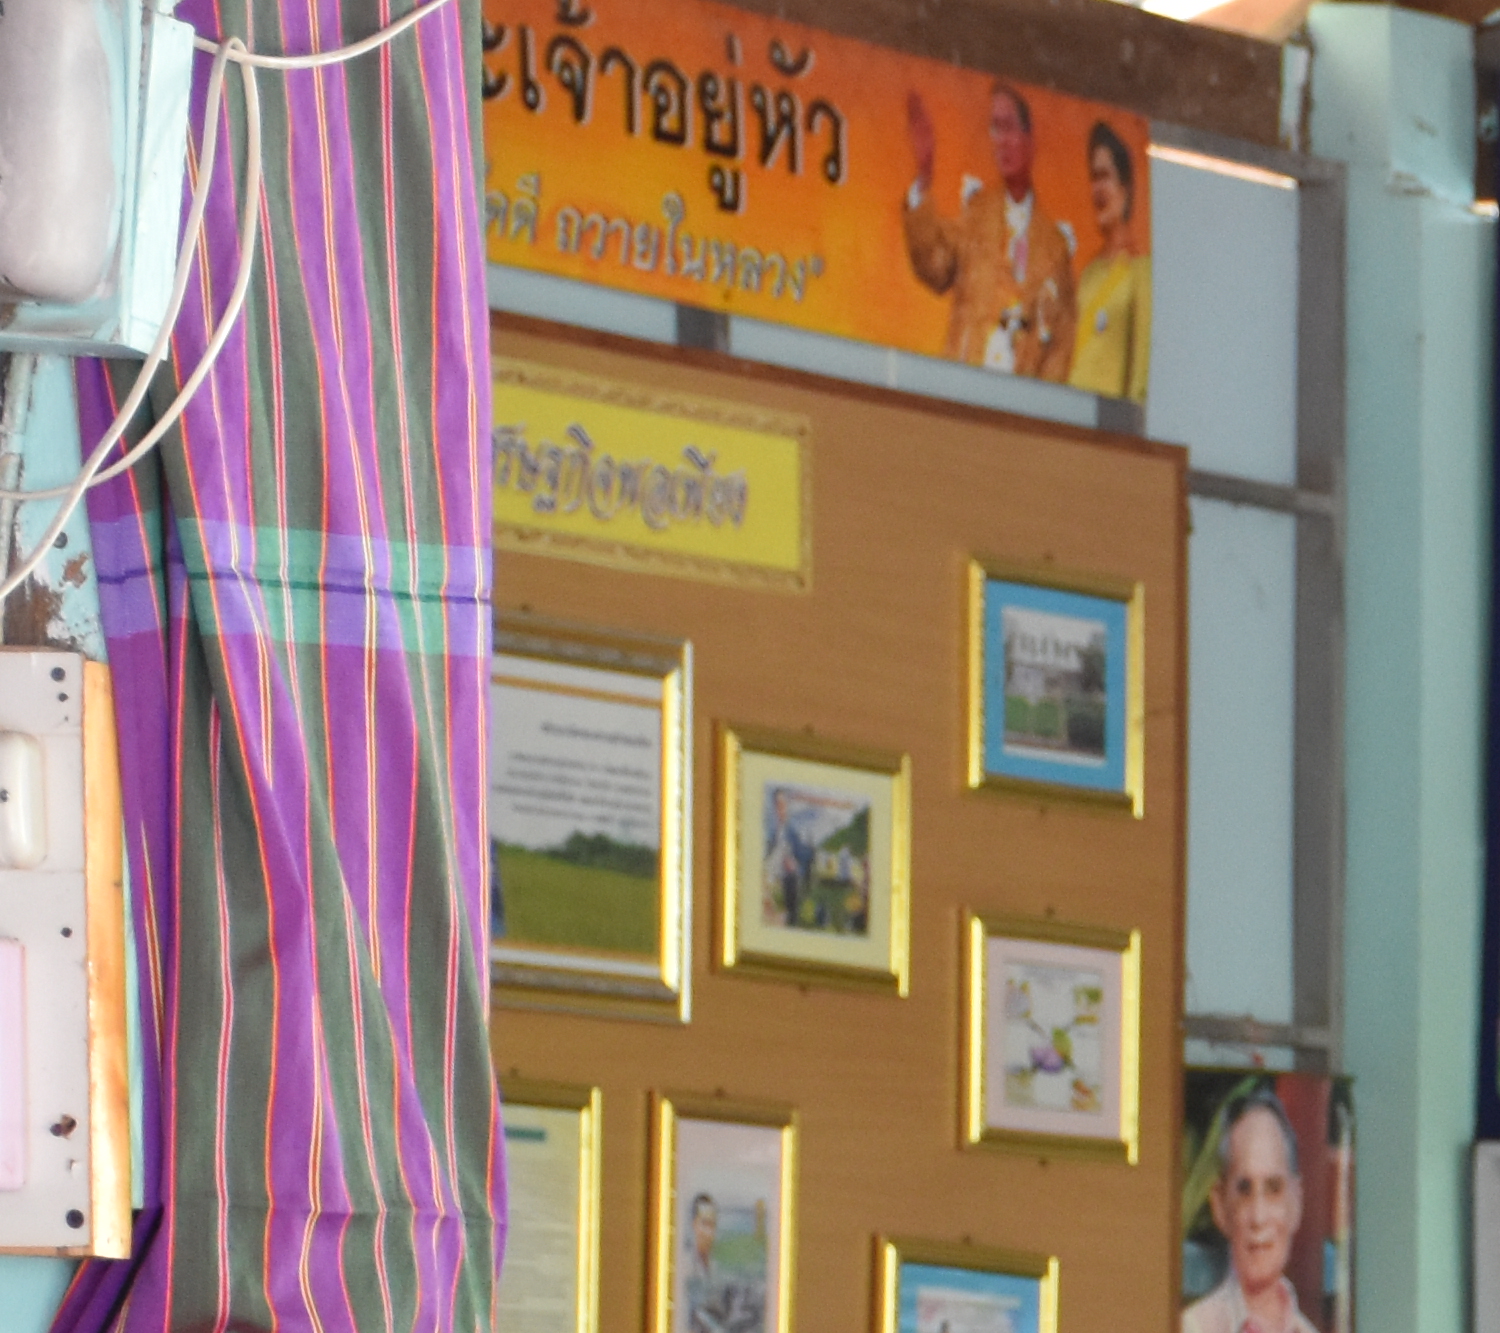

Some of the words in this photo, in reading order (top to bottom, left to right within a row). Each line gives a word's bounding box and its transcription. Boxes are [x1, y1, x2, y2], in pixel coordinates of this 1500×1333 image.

[491, 422, 748, 530] รษฐกิจพอเพียง
